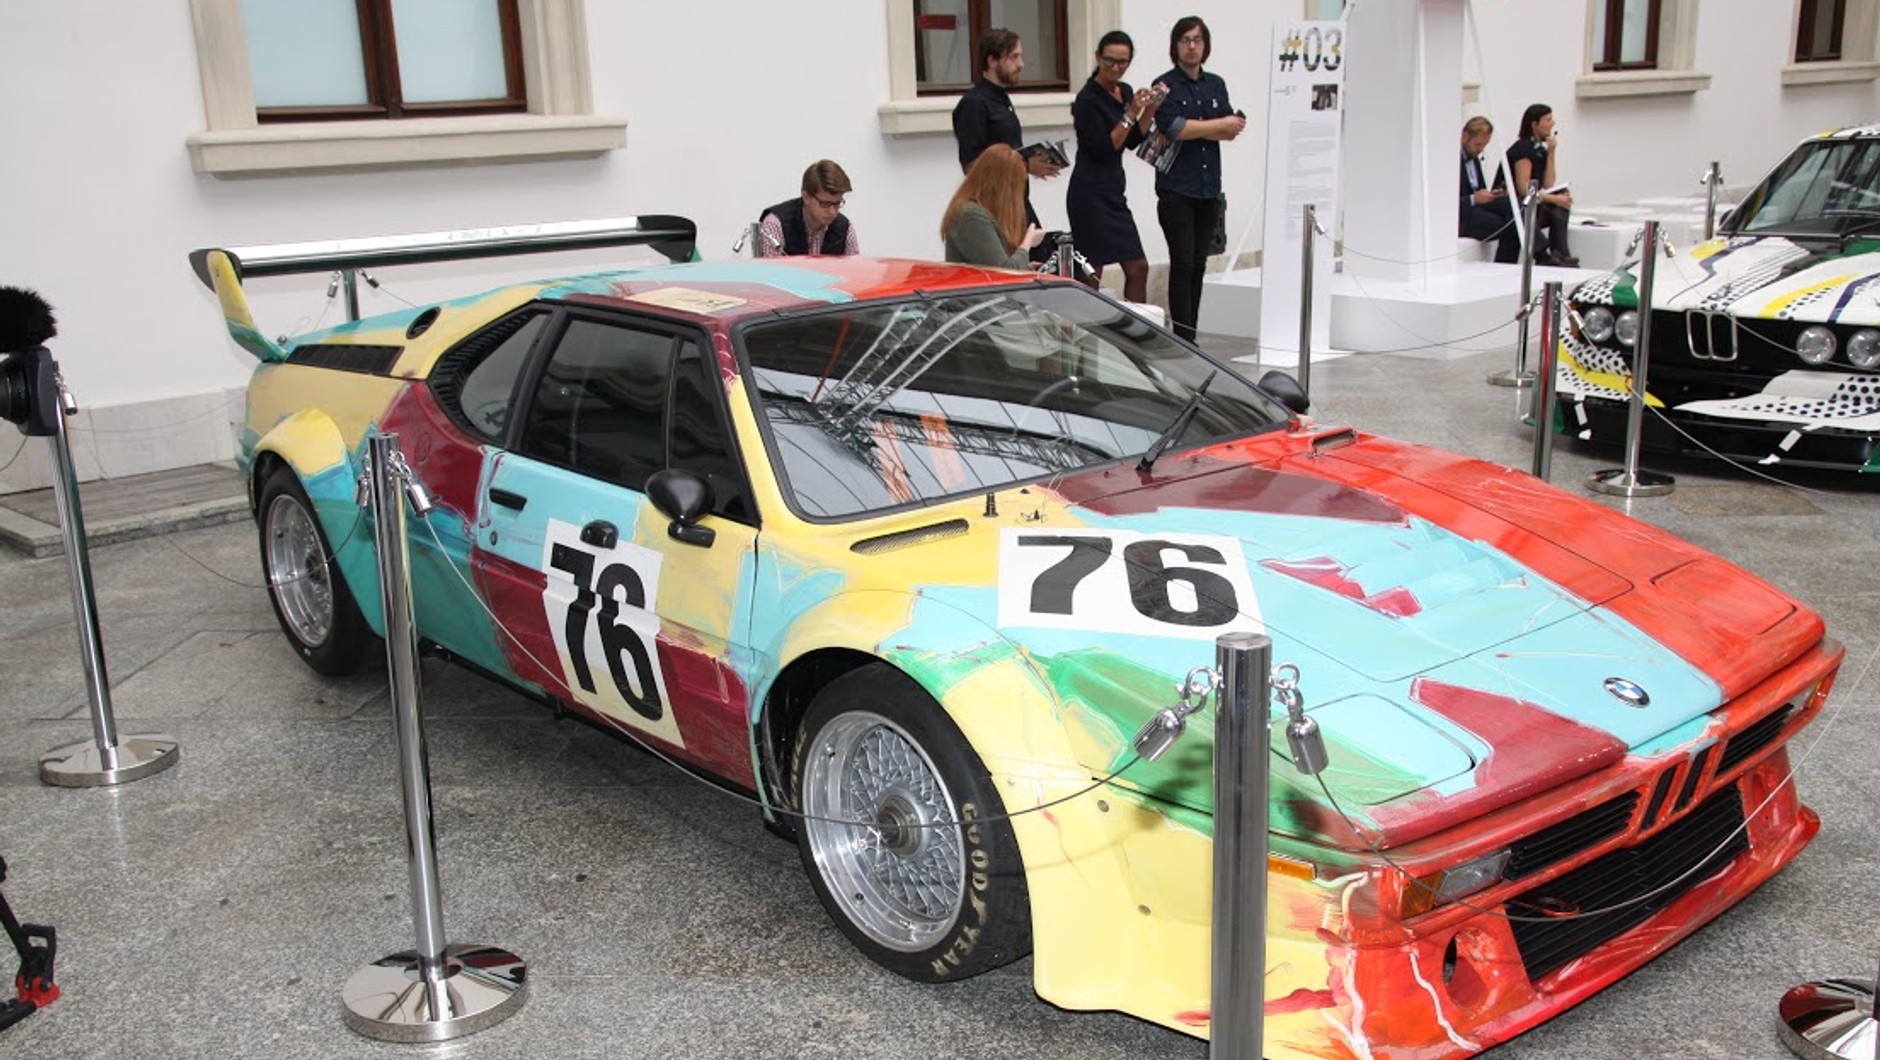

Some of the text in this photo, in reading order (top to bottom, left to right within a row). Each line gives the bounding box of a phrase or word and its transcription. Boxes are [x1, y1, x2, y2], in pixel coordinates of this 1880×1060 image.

[1279, 27, 1342, 72] #03
[1017, 535, 1239, 627] 76
[550, 542, 664, 722] 76
